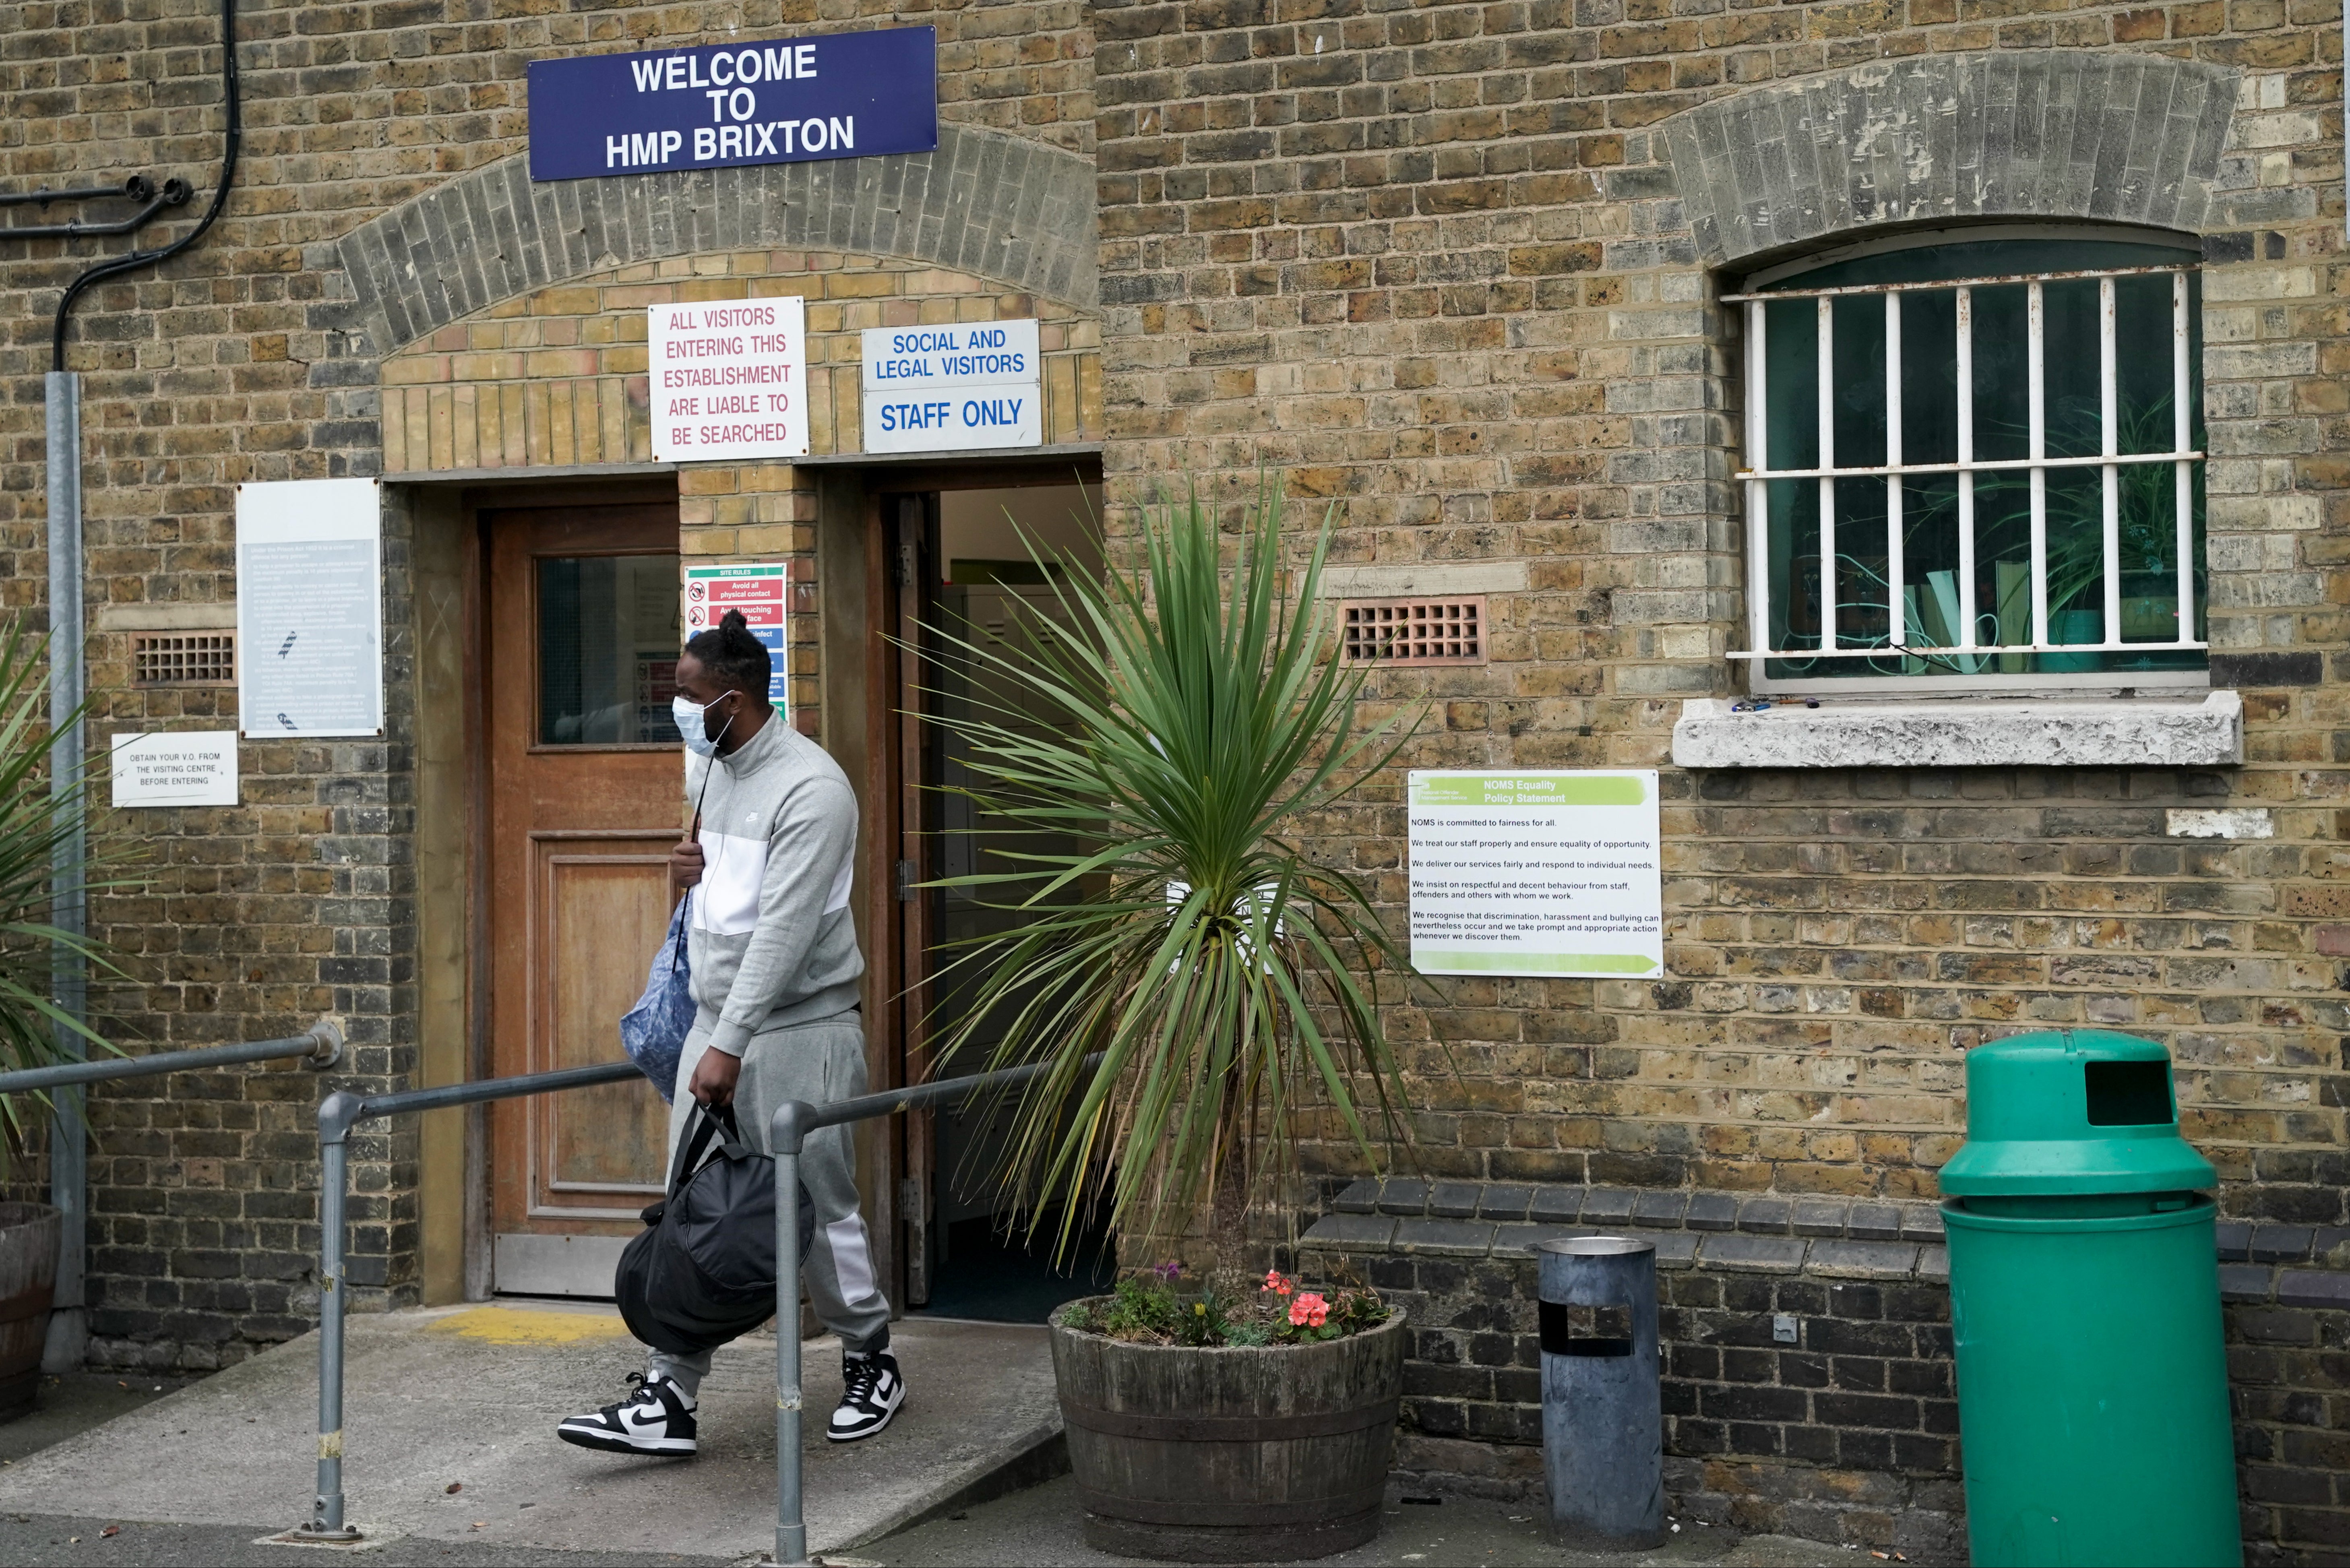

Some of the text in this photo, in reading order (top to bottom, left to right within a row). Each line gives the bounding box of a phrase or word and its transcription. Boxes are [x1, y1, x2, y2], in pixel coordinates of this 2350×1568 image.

[631, 45, 816, 92] WELCOME
[706, 87, 755, 122] TO
[607, 116, 853, 167] HMP BRIXTON
[670, 307, 775, 330] ALL VISITORS
[667, 334, 786, 359] ENTERING THIS
[893, 330, 1005, 354] SOCIAL AND
[664, 365, 791, 388] ESTABLISHMENT
[876, 353, 1024, 379] LEGAL VISITORS
[669, 393, 788, 416] ARE LIABLE TO
[881, 399, 1022, 431] STAFF ONLY
[672, 423, 786, 445] BE SEARCHED
[721, 591, 746, 599] physical
[741, 605, 771, 614] touching
[1484, 781, 1555, 791] NOMS Equality
[1485, 794, 1565, 804] Policy Statement
[1480, 840, 1511, 849] properly
[1560, 840, 1591, 849] equality
[1604, 841, 1651, 849] opportunity.
[1504, 861, 1523, 870] fairly
[1542, 861, 1574, 869] respond
[1461, 881, 1500, 890] respectful
[1537, 924, 1565, 932] prompt
[1610, 914, 1642, 923] bullying
